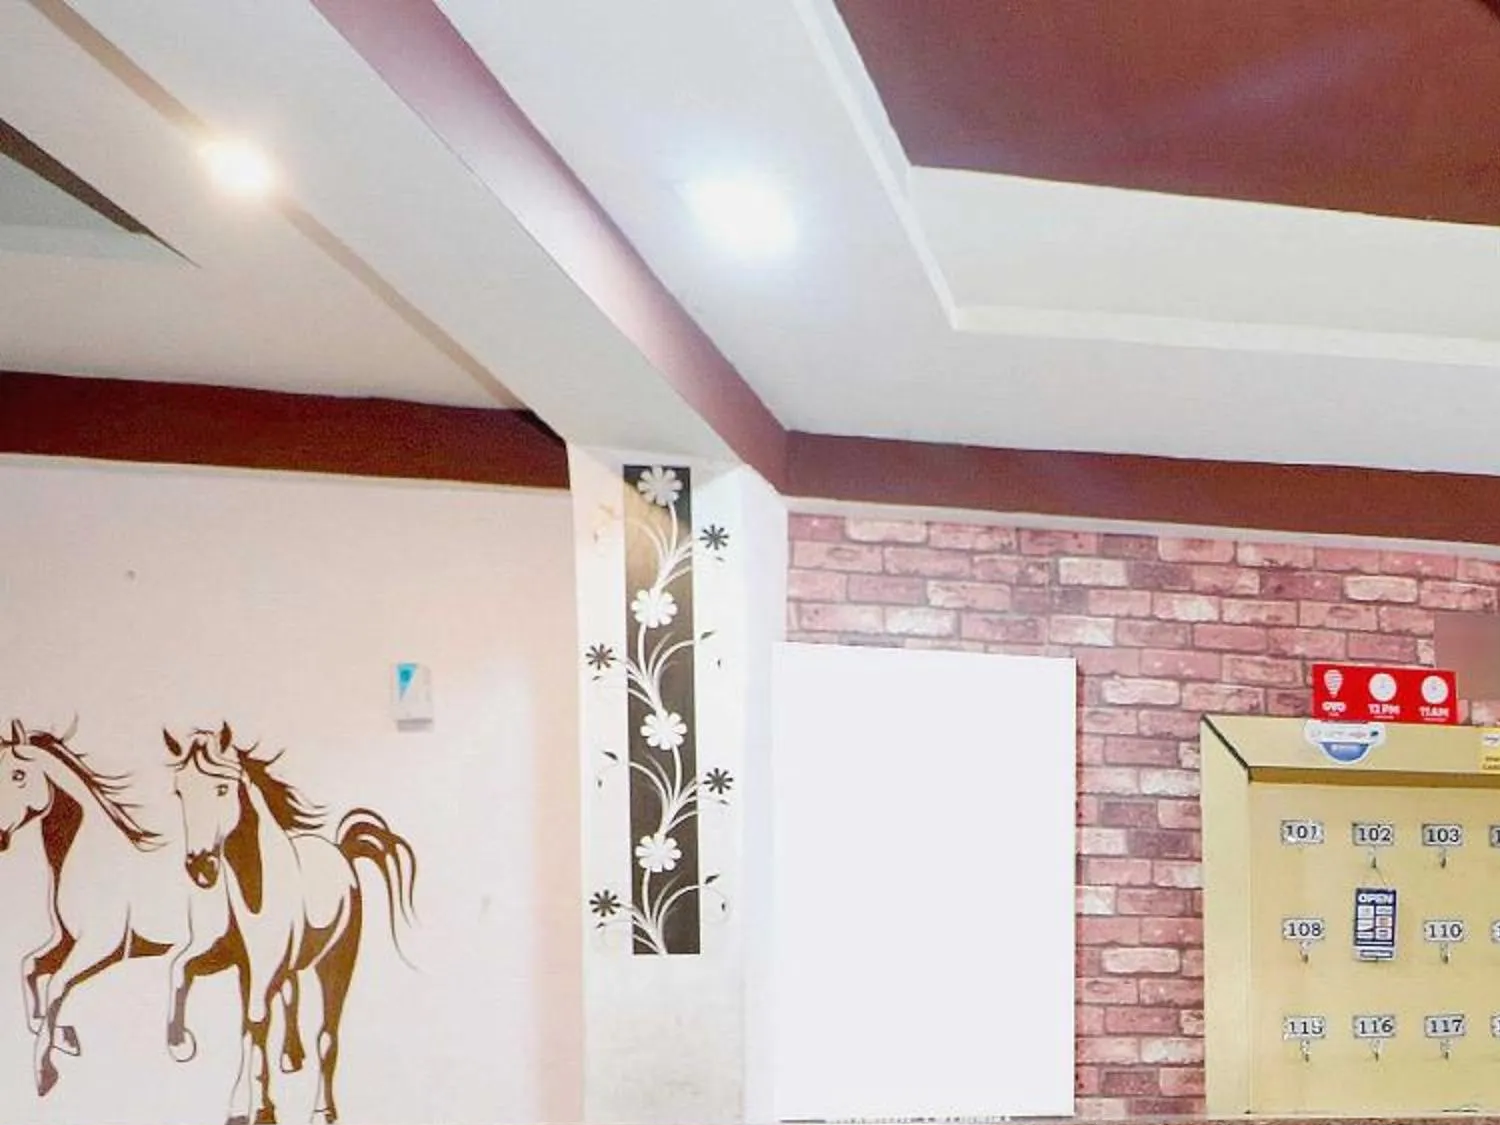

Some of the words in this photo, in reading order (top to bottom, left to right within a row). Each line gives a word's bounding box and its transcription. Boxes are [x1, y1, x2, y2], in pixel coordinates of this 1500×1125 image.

[1285, 825, 1317, 840] 101
[1359, 827, 1391, 841] 102
[1428, 828, 1460, 842] 103
[1358, 893, 1393, 904] OPEN
[1288, 923, 1322, 937] 108
[1429, 923, 1462, 938] 110
[1360, 1019, 1393, 1034] 116
[1431, 1019, 1463, 1033] 117
